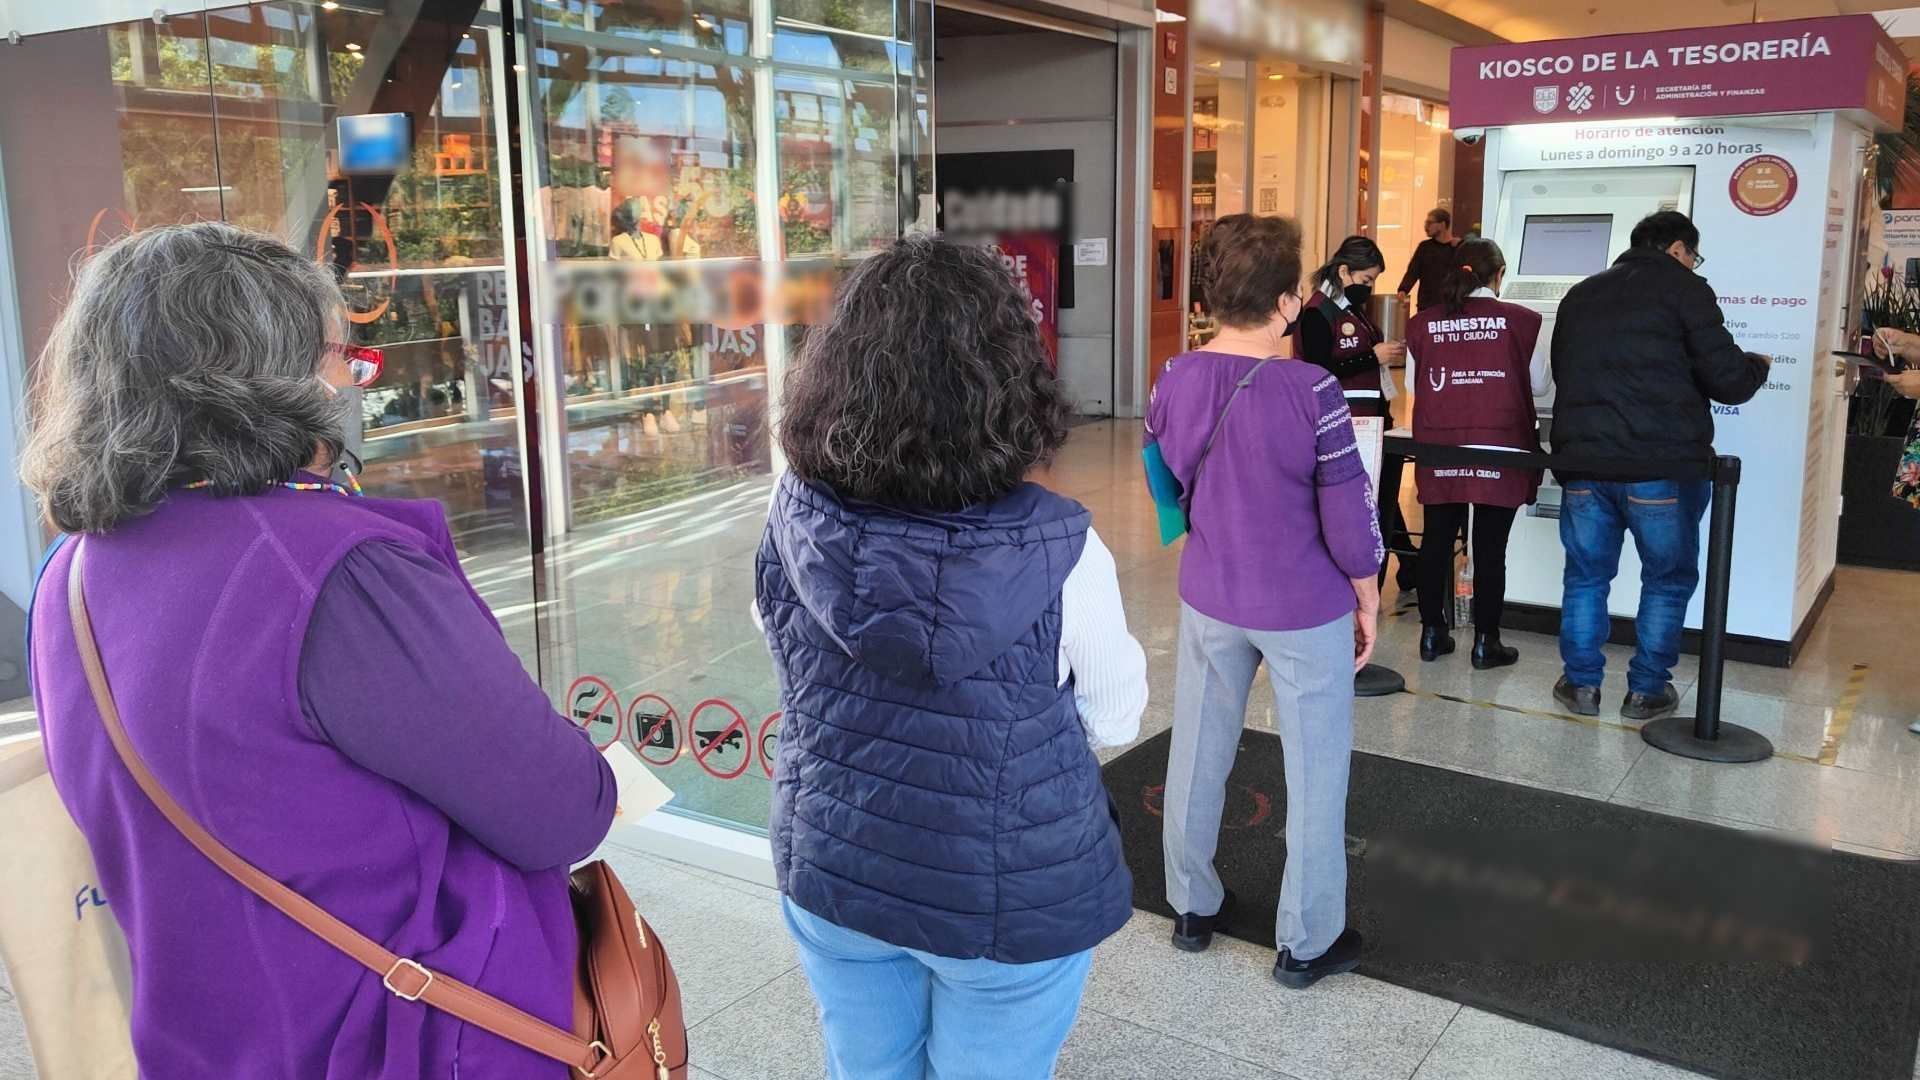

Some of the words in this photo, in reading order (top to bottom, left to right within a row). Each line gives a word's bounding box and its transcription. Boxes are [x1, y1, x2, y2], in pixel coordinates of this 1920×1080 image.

[1479, 55, 1574, 80] KIOSCO
[1582, 52, 1617, 72] DE
[1625, 49, 1659, 69] LA
[1668, 32, 1831, 67] TESORERÍA
[1656, 84, 1700, 93] SECRETARÍA
[1656, 91, 1718, 100] ADMINISTRACIÓN
[1727, 88, 1765, 97] FINANZAS
[1576, 127, 1630, 140] Horario
[1635, 126, 1654, 137] de
[1657, 125, 1725, 136] atención
[1541, 149, 1582, 161] Lunes
[1586, 151, 1594, 159] a
[1598, 145, 1664, 160] domingo
[1669, 144, 1678, 157] 9
[1682, 147, 1690, 156] a
[1695, 143, 1713, 155] 20
[1717, 142, 1763, 155] horas
[1716, 296, 1746, 305] mas
[1750, 294, 1767, 305] de
[1771, 297, 1807, 308] pago
[1428, 317, 1506, 333] BIENESTAR
[1726, 319, 1748, 329] tivo
[1340, 336, 1359, 349] SAF
[1433, 334, 1444, 343] EN
[1448, 333, 1460, 342] TU
[1464, 331, 1498, 341] CIUDAD
[1773, 354, 1797, 365] dito
[1712, 405, 1740, 416] VISA
[75, 884, 107, 921] FL
